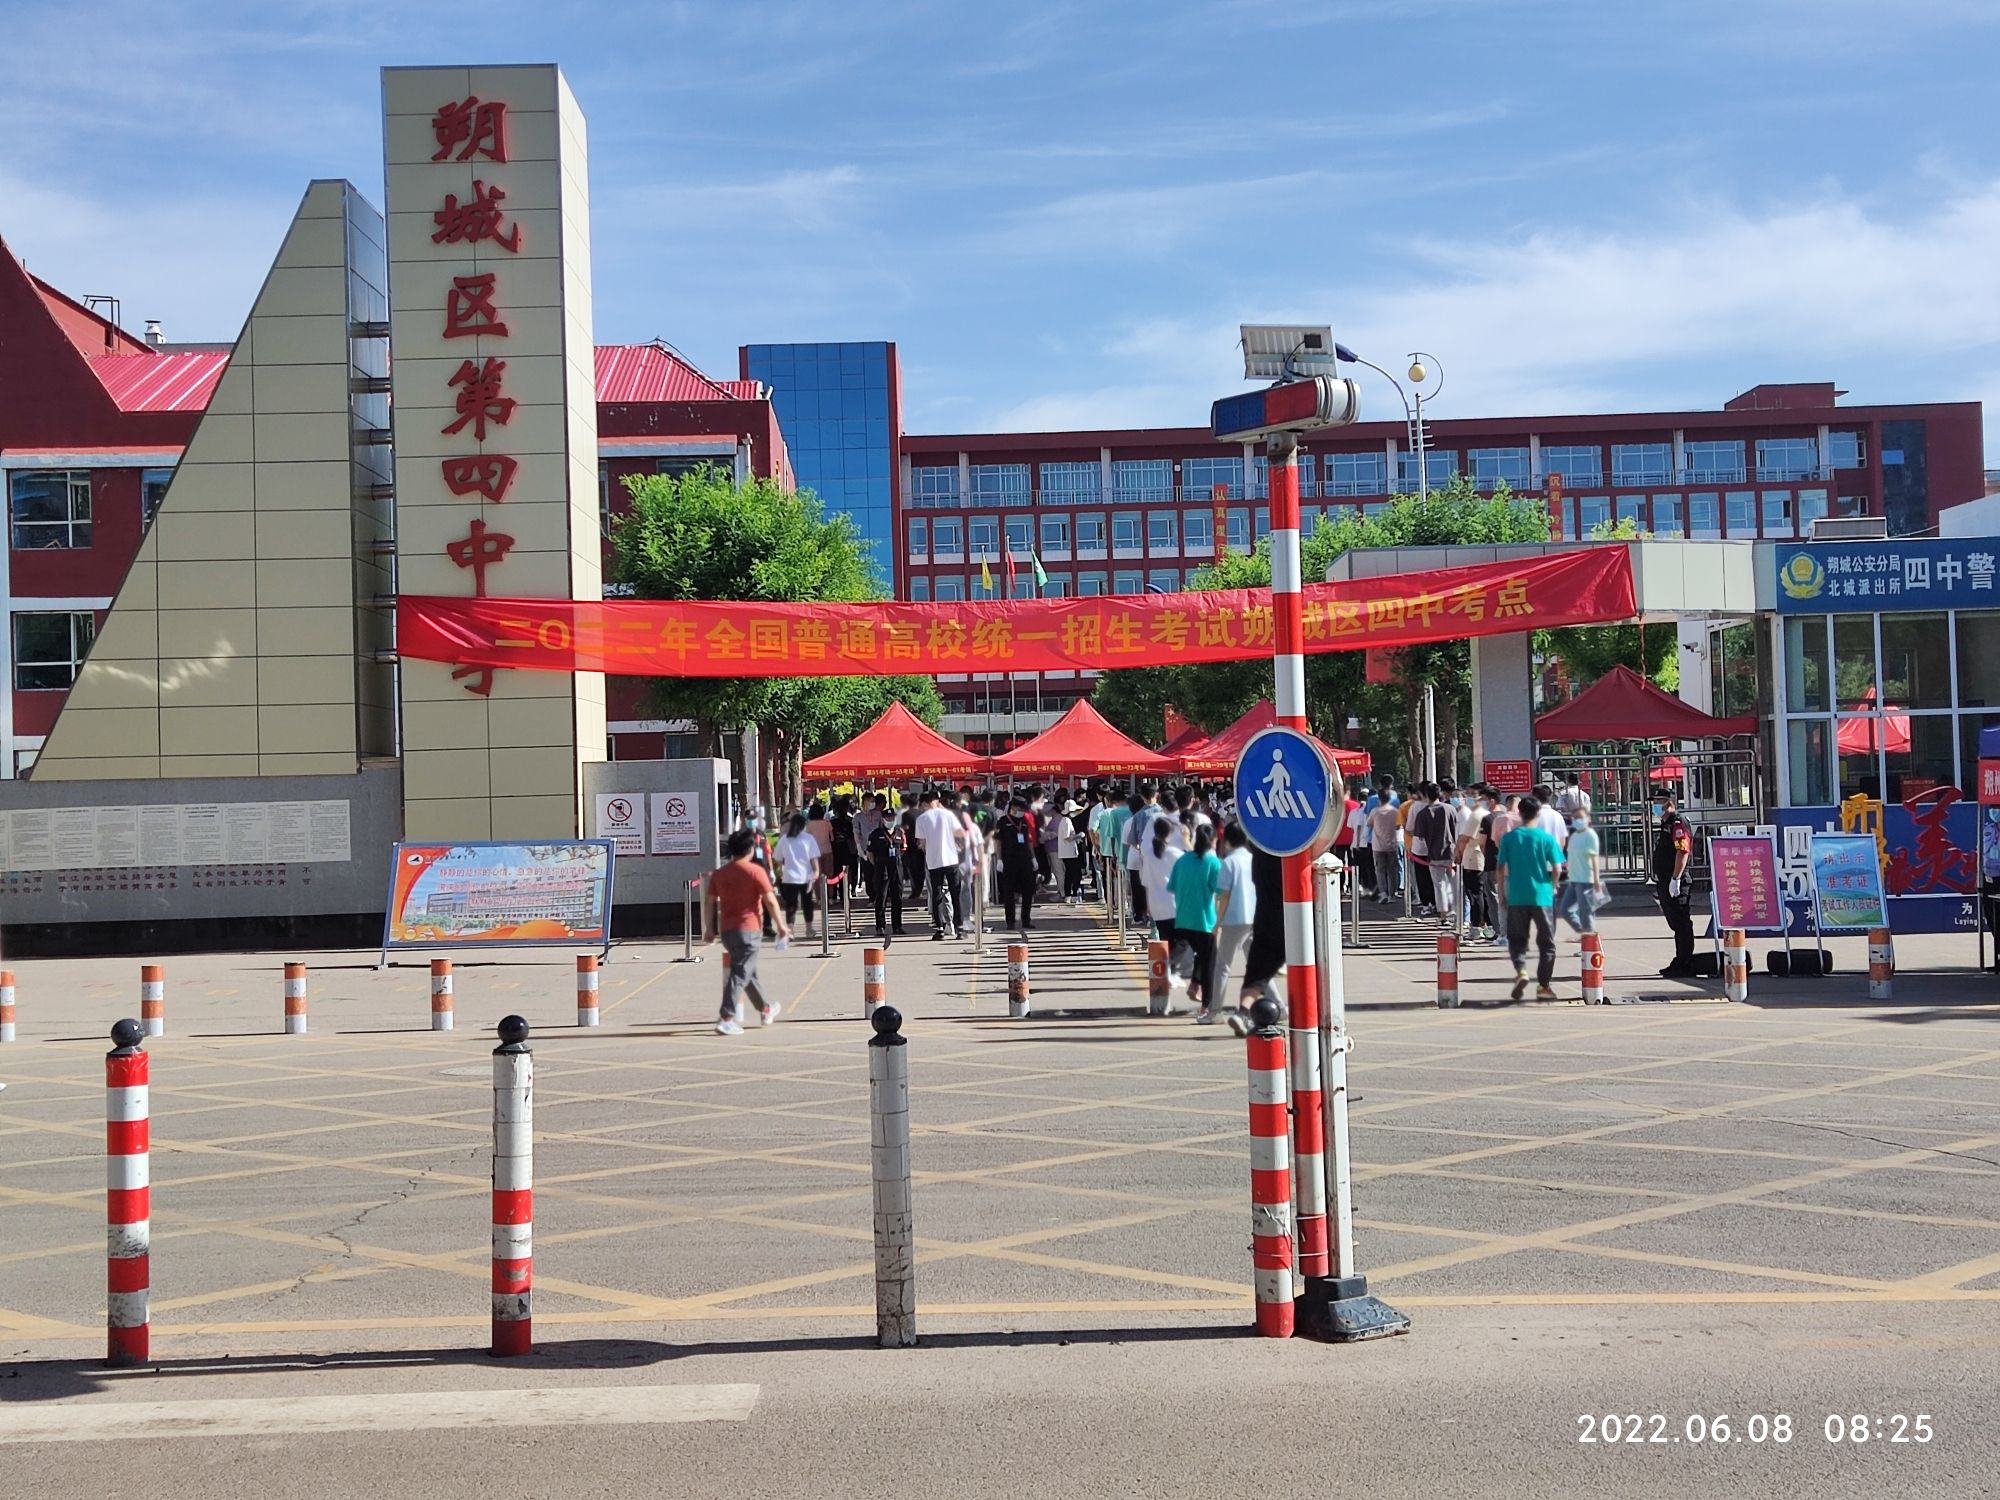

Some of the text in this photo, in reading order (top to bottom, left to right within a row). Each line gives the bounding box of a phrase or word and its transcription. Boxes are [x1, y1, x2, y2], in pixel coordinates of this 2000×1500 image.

[1827, 554, 1901, 574] 朔城公安分局
[1904, 552, 2000, 591] 四中警
[1828, 577, 1901, 597] 北城派出所
[1823, 852, 1866, 865] 请出示
[1826, 874, 1869, 889] 准考证
